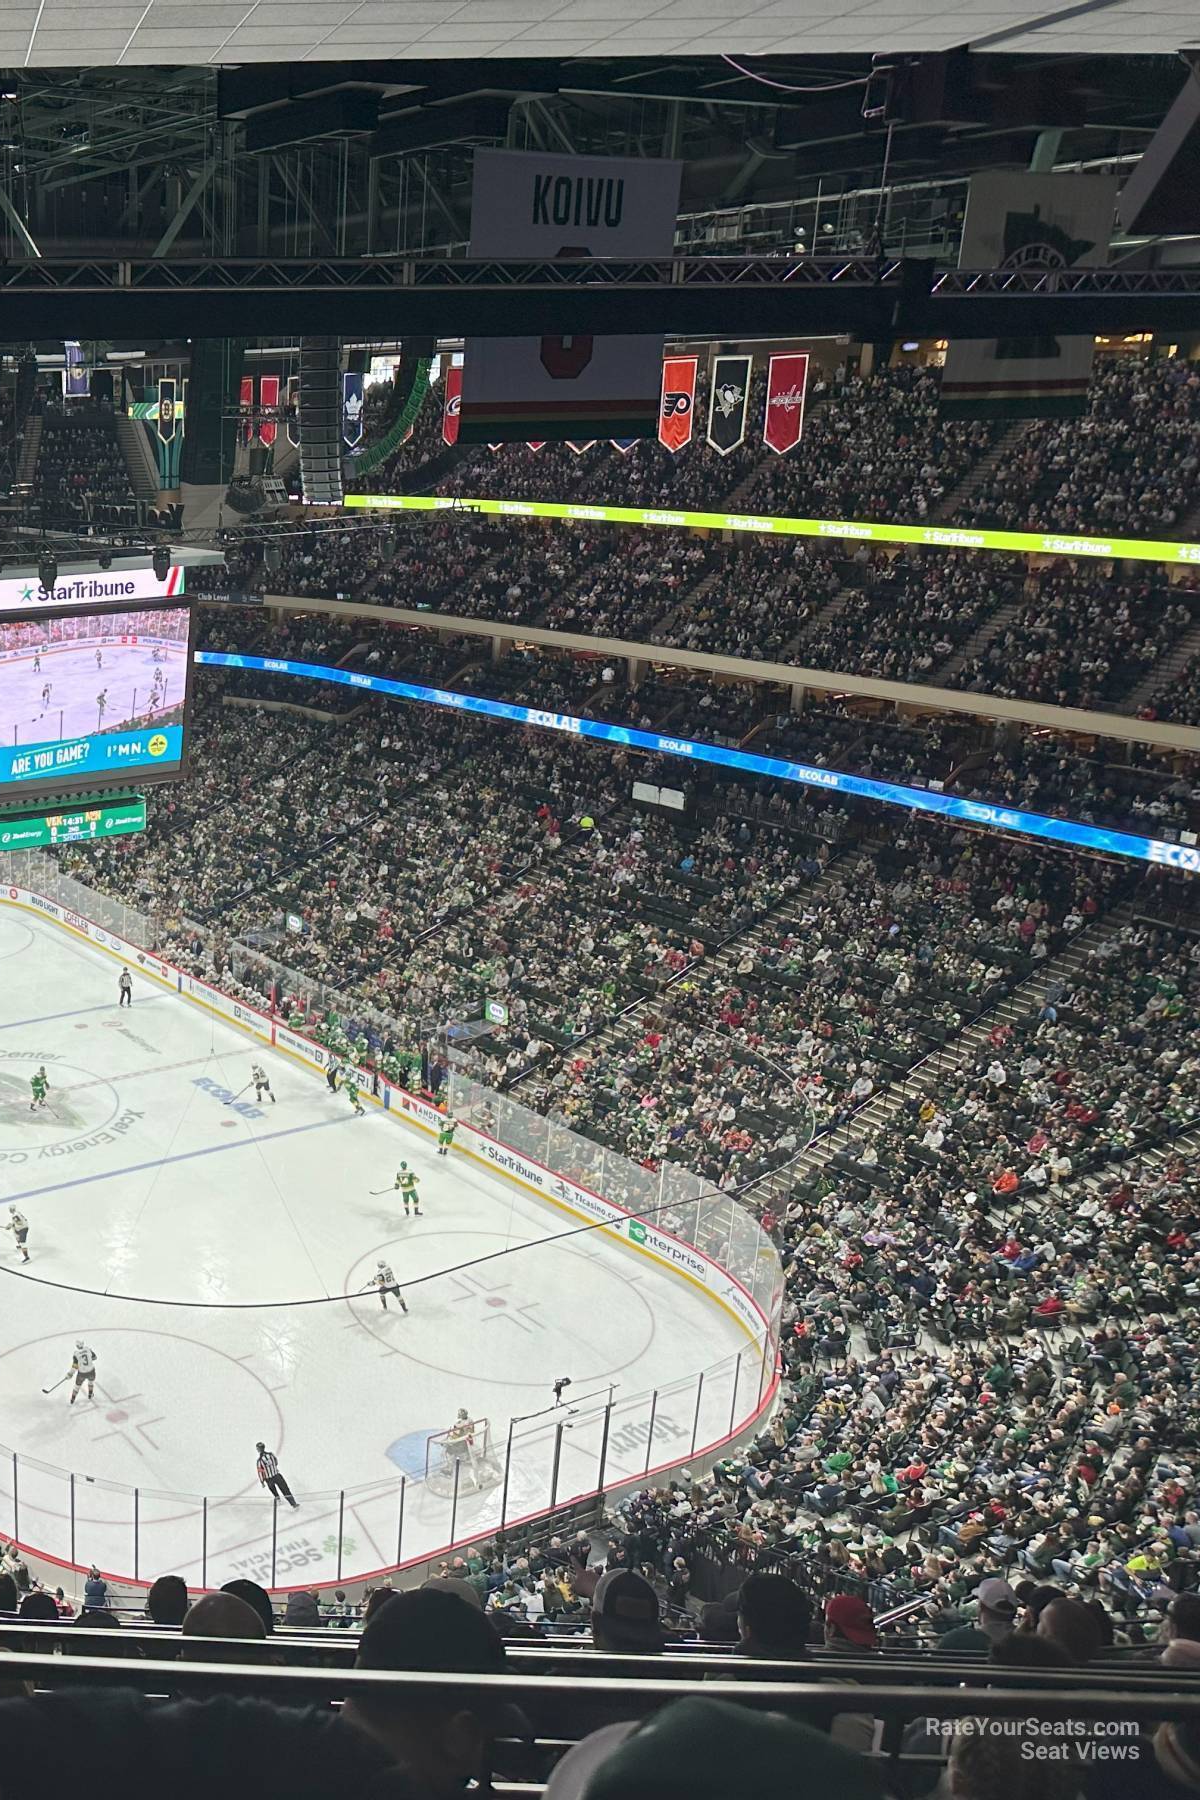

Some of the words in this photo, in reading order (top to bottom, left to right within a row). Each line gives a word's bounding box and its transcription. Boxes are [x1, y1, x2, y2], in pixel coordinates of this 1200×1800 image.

[532, 174, 625, 228] KOIVU
[932, 530, 985, 546] StarTribune
[1053, 539, 1112, 554] StarTribune
[37, 581, 135, 601] StarTribune
[197, 592, 212, 600] Club
[213, 593, 230, 601] Level
[525, 708, 581, 734] ECOLAB
[657, 737, 693, 755] ECOLAB
[11, 756, 32, 775] ARE
[34, 750, 55, 768] YOU
[57, 743, 90, 763] GAME?
[798, 768, 839, 787] ECOLAB
[63, 816, 84, 827] 14:31
[31, 896, 44, 910] BUD
[43, 903, 59, 916] LIGHT
[63, 911, 89, 930] LOFFLER
[108, 1108, 146, 1136] Xcel
[36, 1129, 117, 1160] Energy
[488, 1146, 543, 1185] StarTribune
[630, 1225, 705, 1274] enterprise
[81, 1353, 90, 1367] 3
[229, 1537, 310, 1571] FINANCIAL
